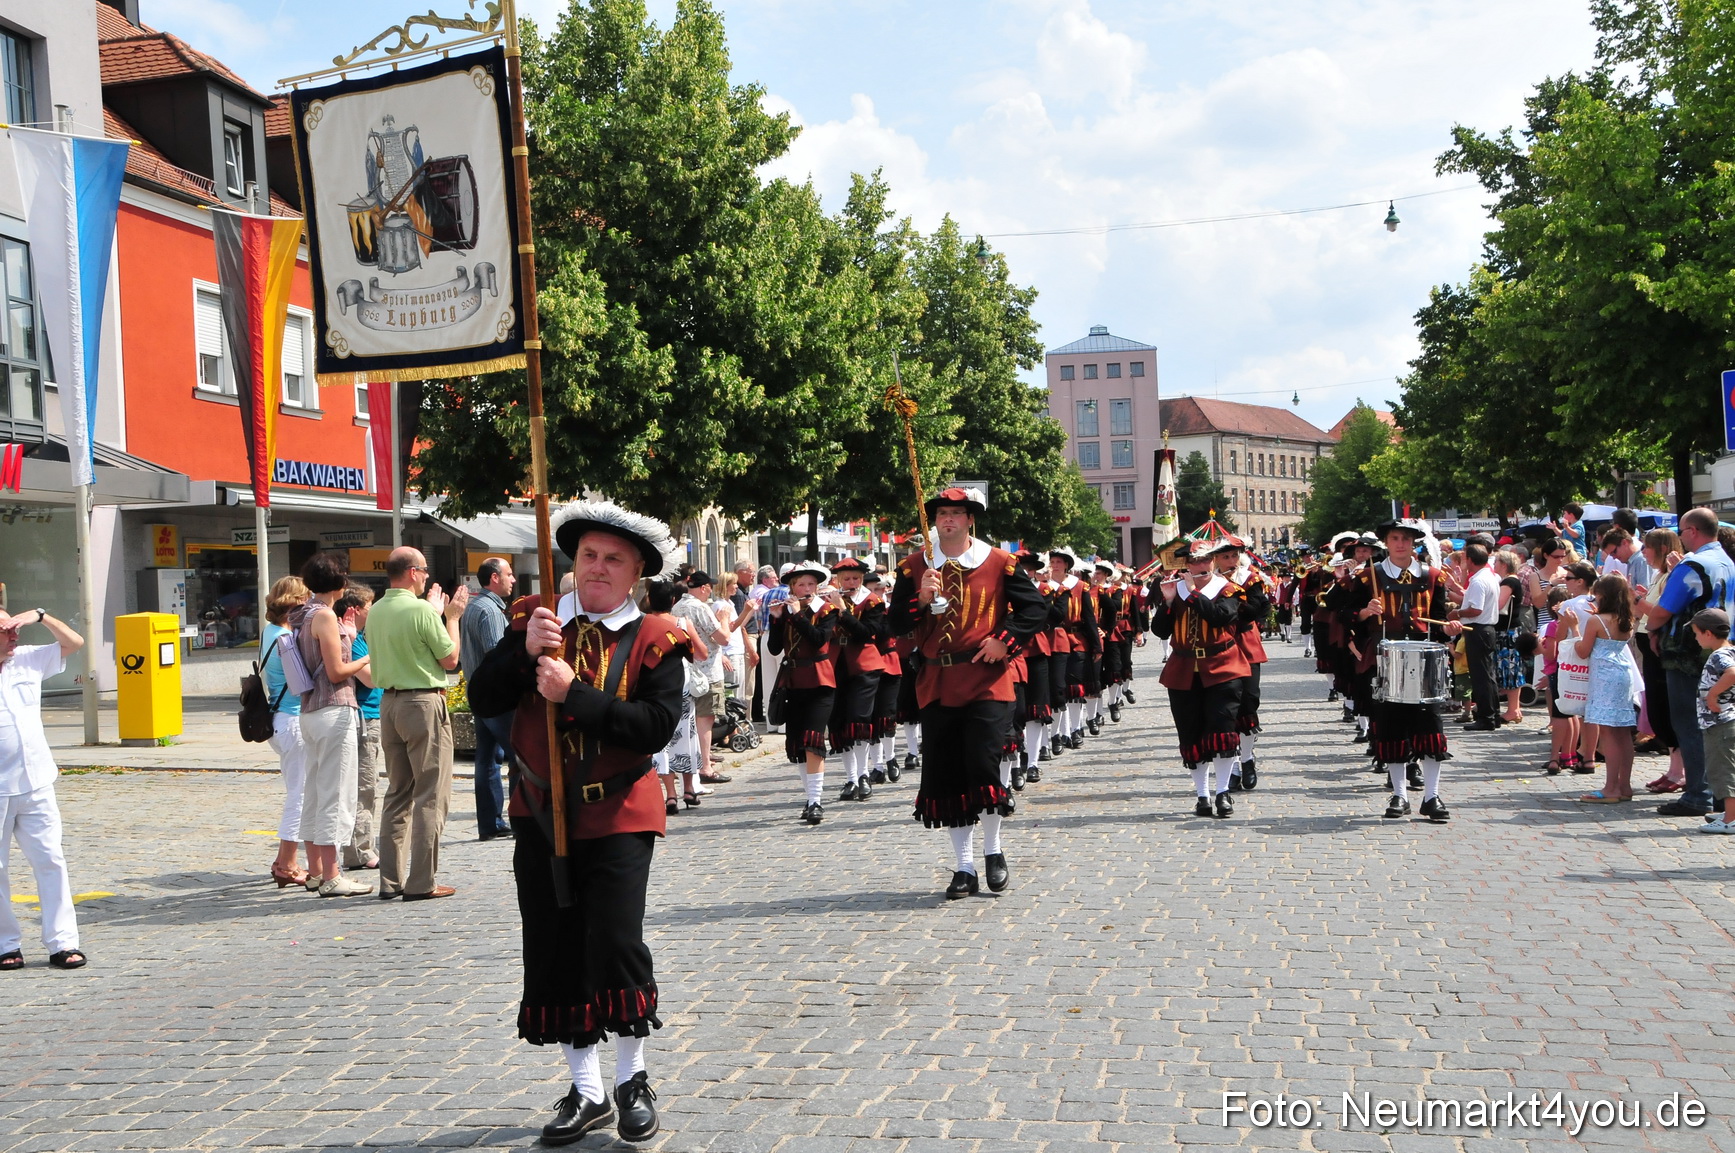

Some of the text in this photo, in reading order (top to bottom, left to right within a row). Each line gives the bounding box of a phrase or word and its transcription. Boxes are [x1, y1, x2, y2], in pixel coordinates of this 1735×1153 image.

[386, 304, 457, 329] Lupburg
[272, 458, 366, 491] BAKWAREN
[234, 532, 253, 541] NZ
[325, 533, 368, 542] NEUMARKTER
[156, 547, 176, 556] LOTTO
